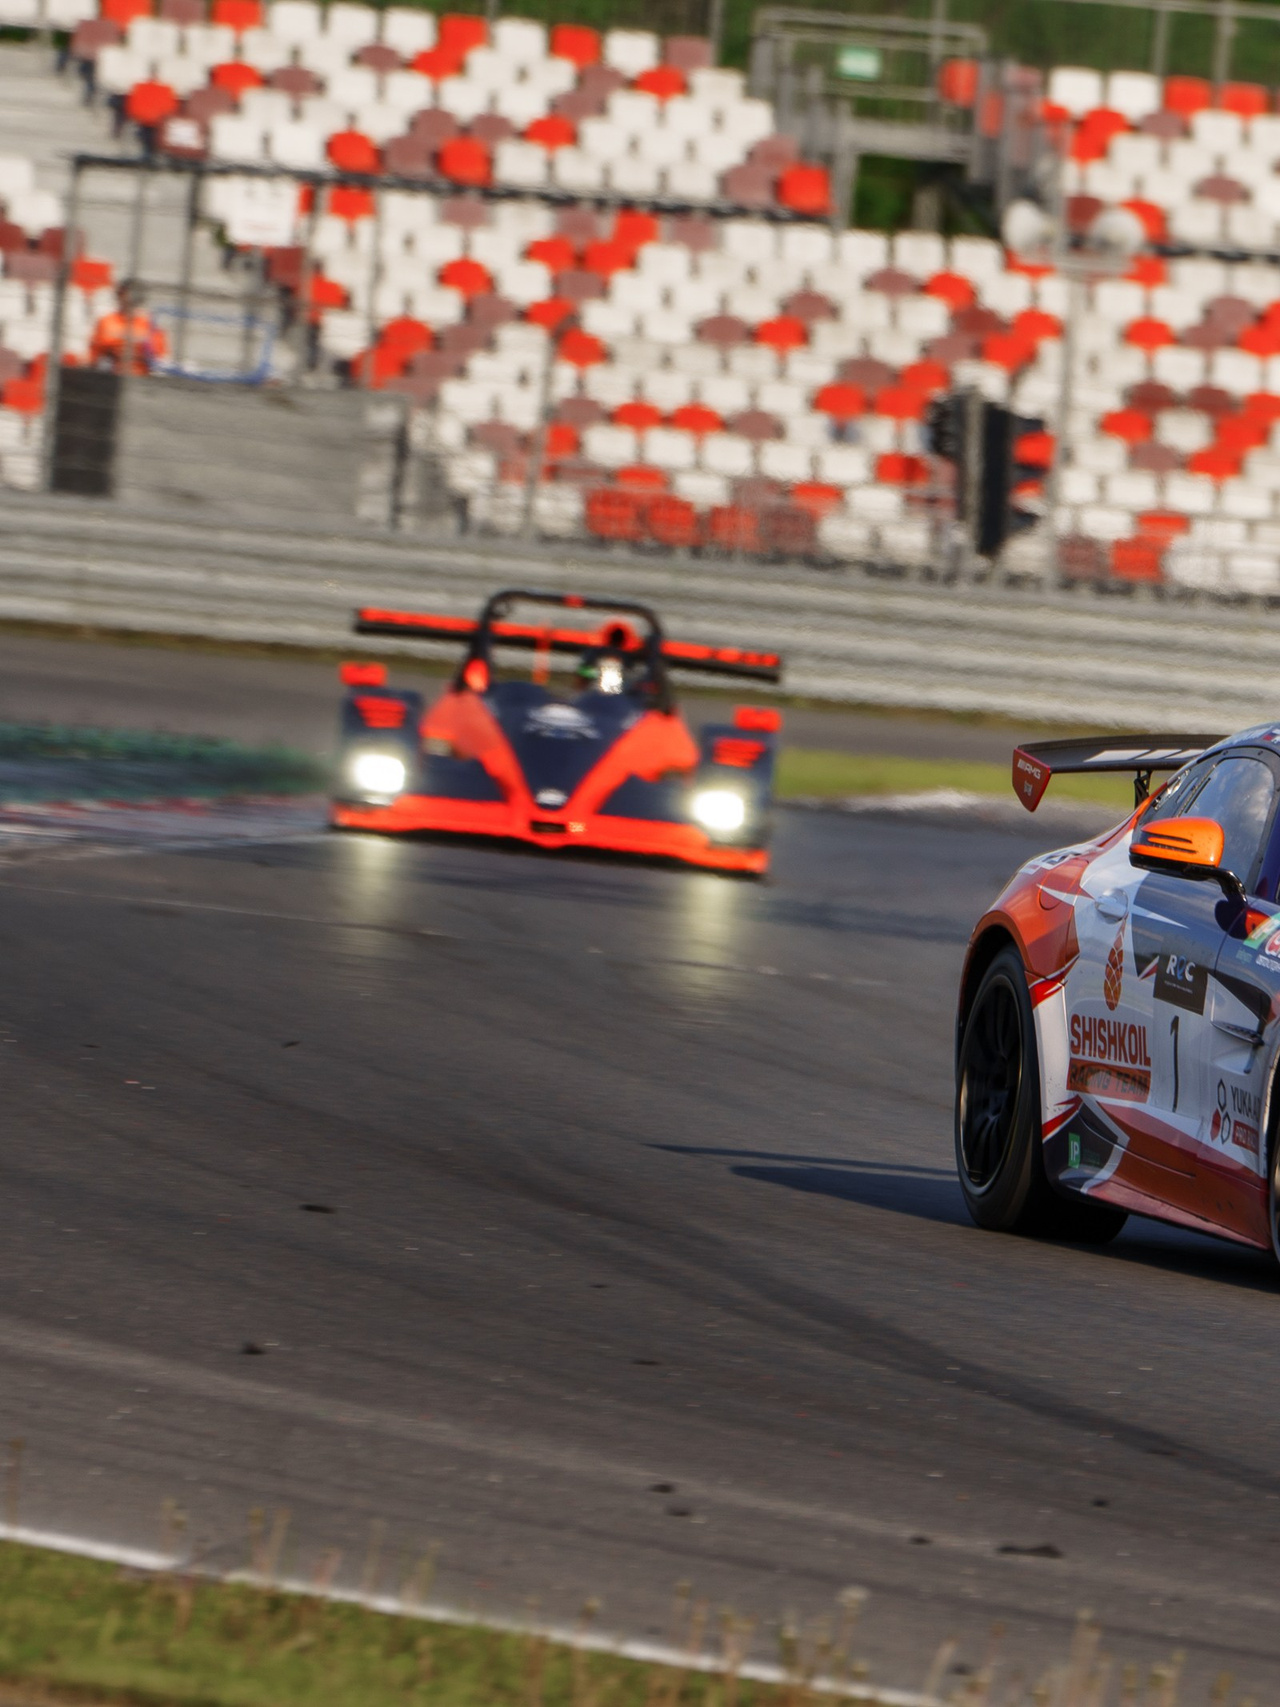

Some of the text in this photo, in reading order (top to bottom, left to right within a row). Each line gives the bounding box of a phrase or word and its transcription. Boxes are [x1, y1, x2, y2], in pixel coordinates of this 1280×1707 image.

[1070, 1013, 1152, 1067] SHISHKOIL
[1169, 1014, 1180, 1113] 1
[1069, 1063, 1149, 1096] RACING TEAM
